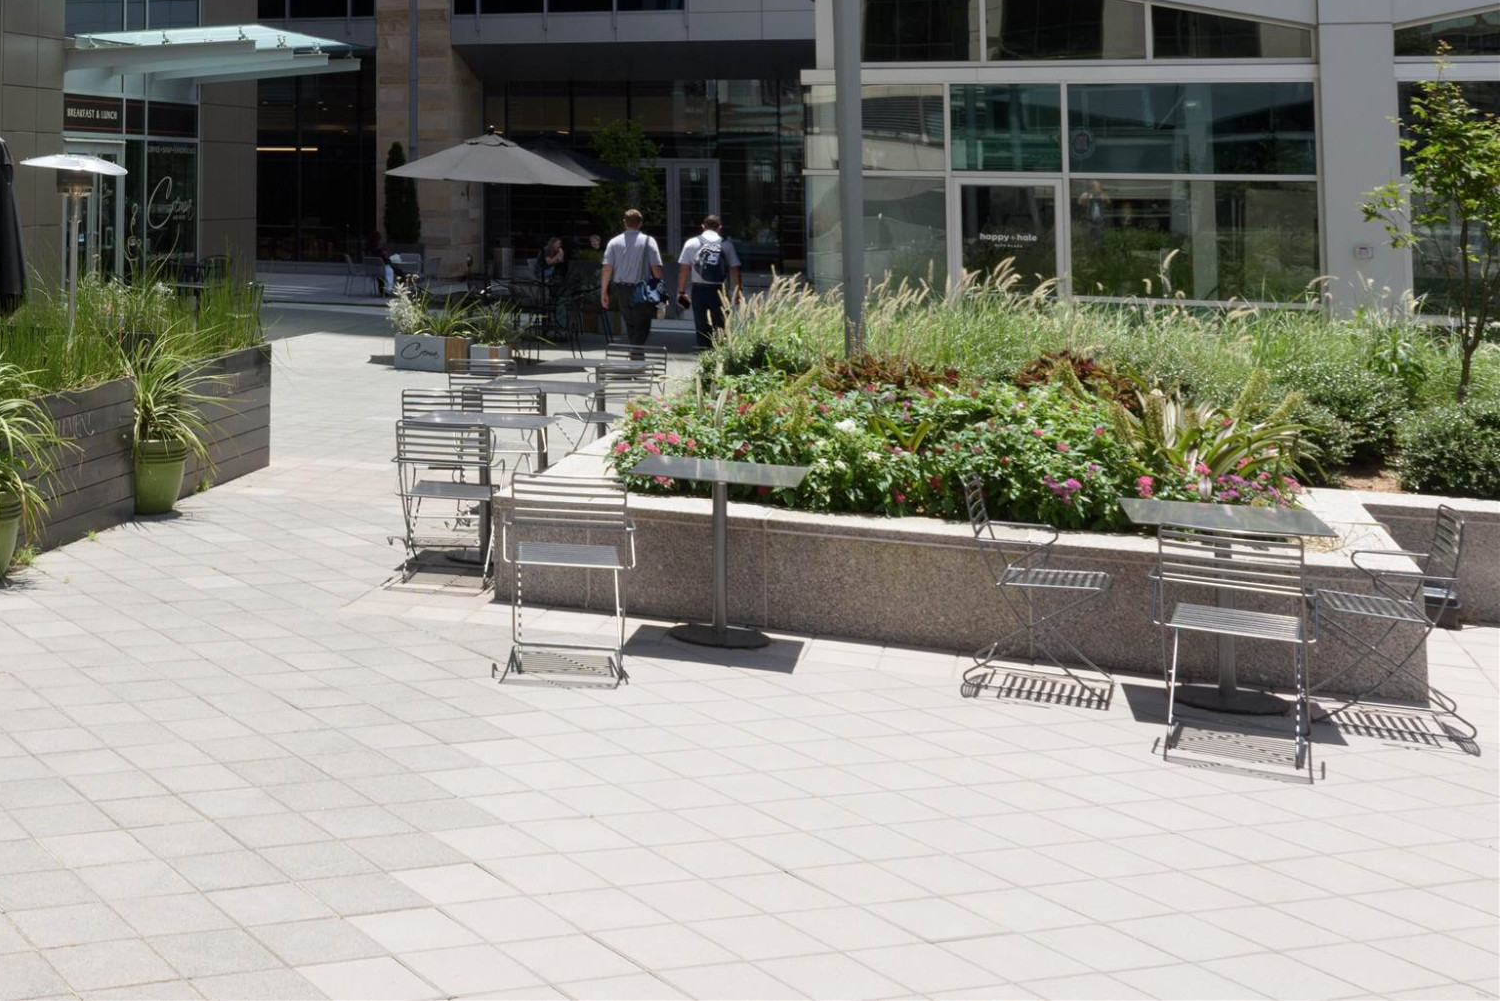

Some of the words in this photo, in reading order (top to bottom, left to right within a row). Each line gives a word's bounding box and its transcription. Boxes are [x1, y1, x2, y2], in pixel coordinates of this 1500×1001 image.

[66, 107, 95, 118] BREAKFAST
[101, 110, 118, 120] LUNCH
[979, 233, 1009, 242] happy
[1016, 233, 1038, 242] hale
